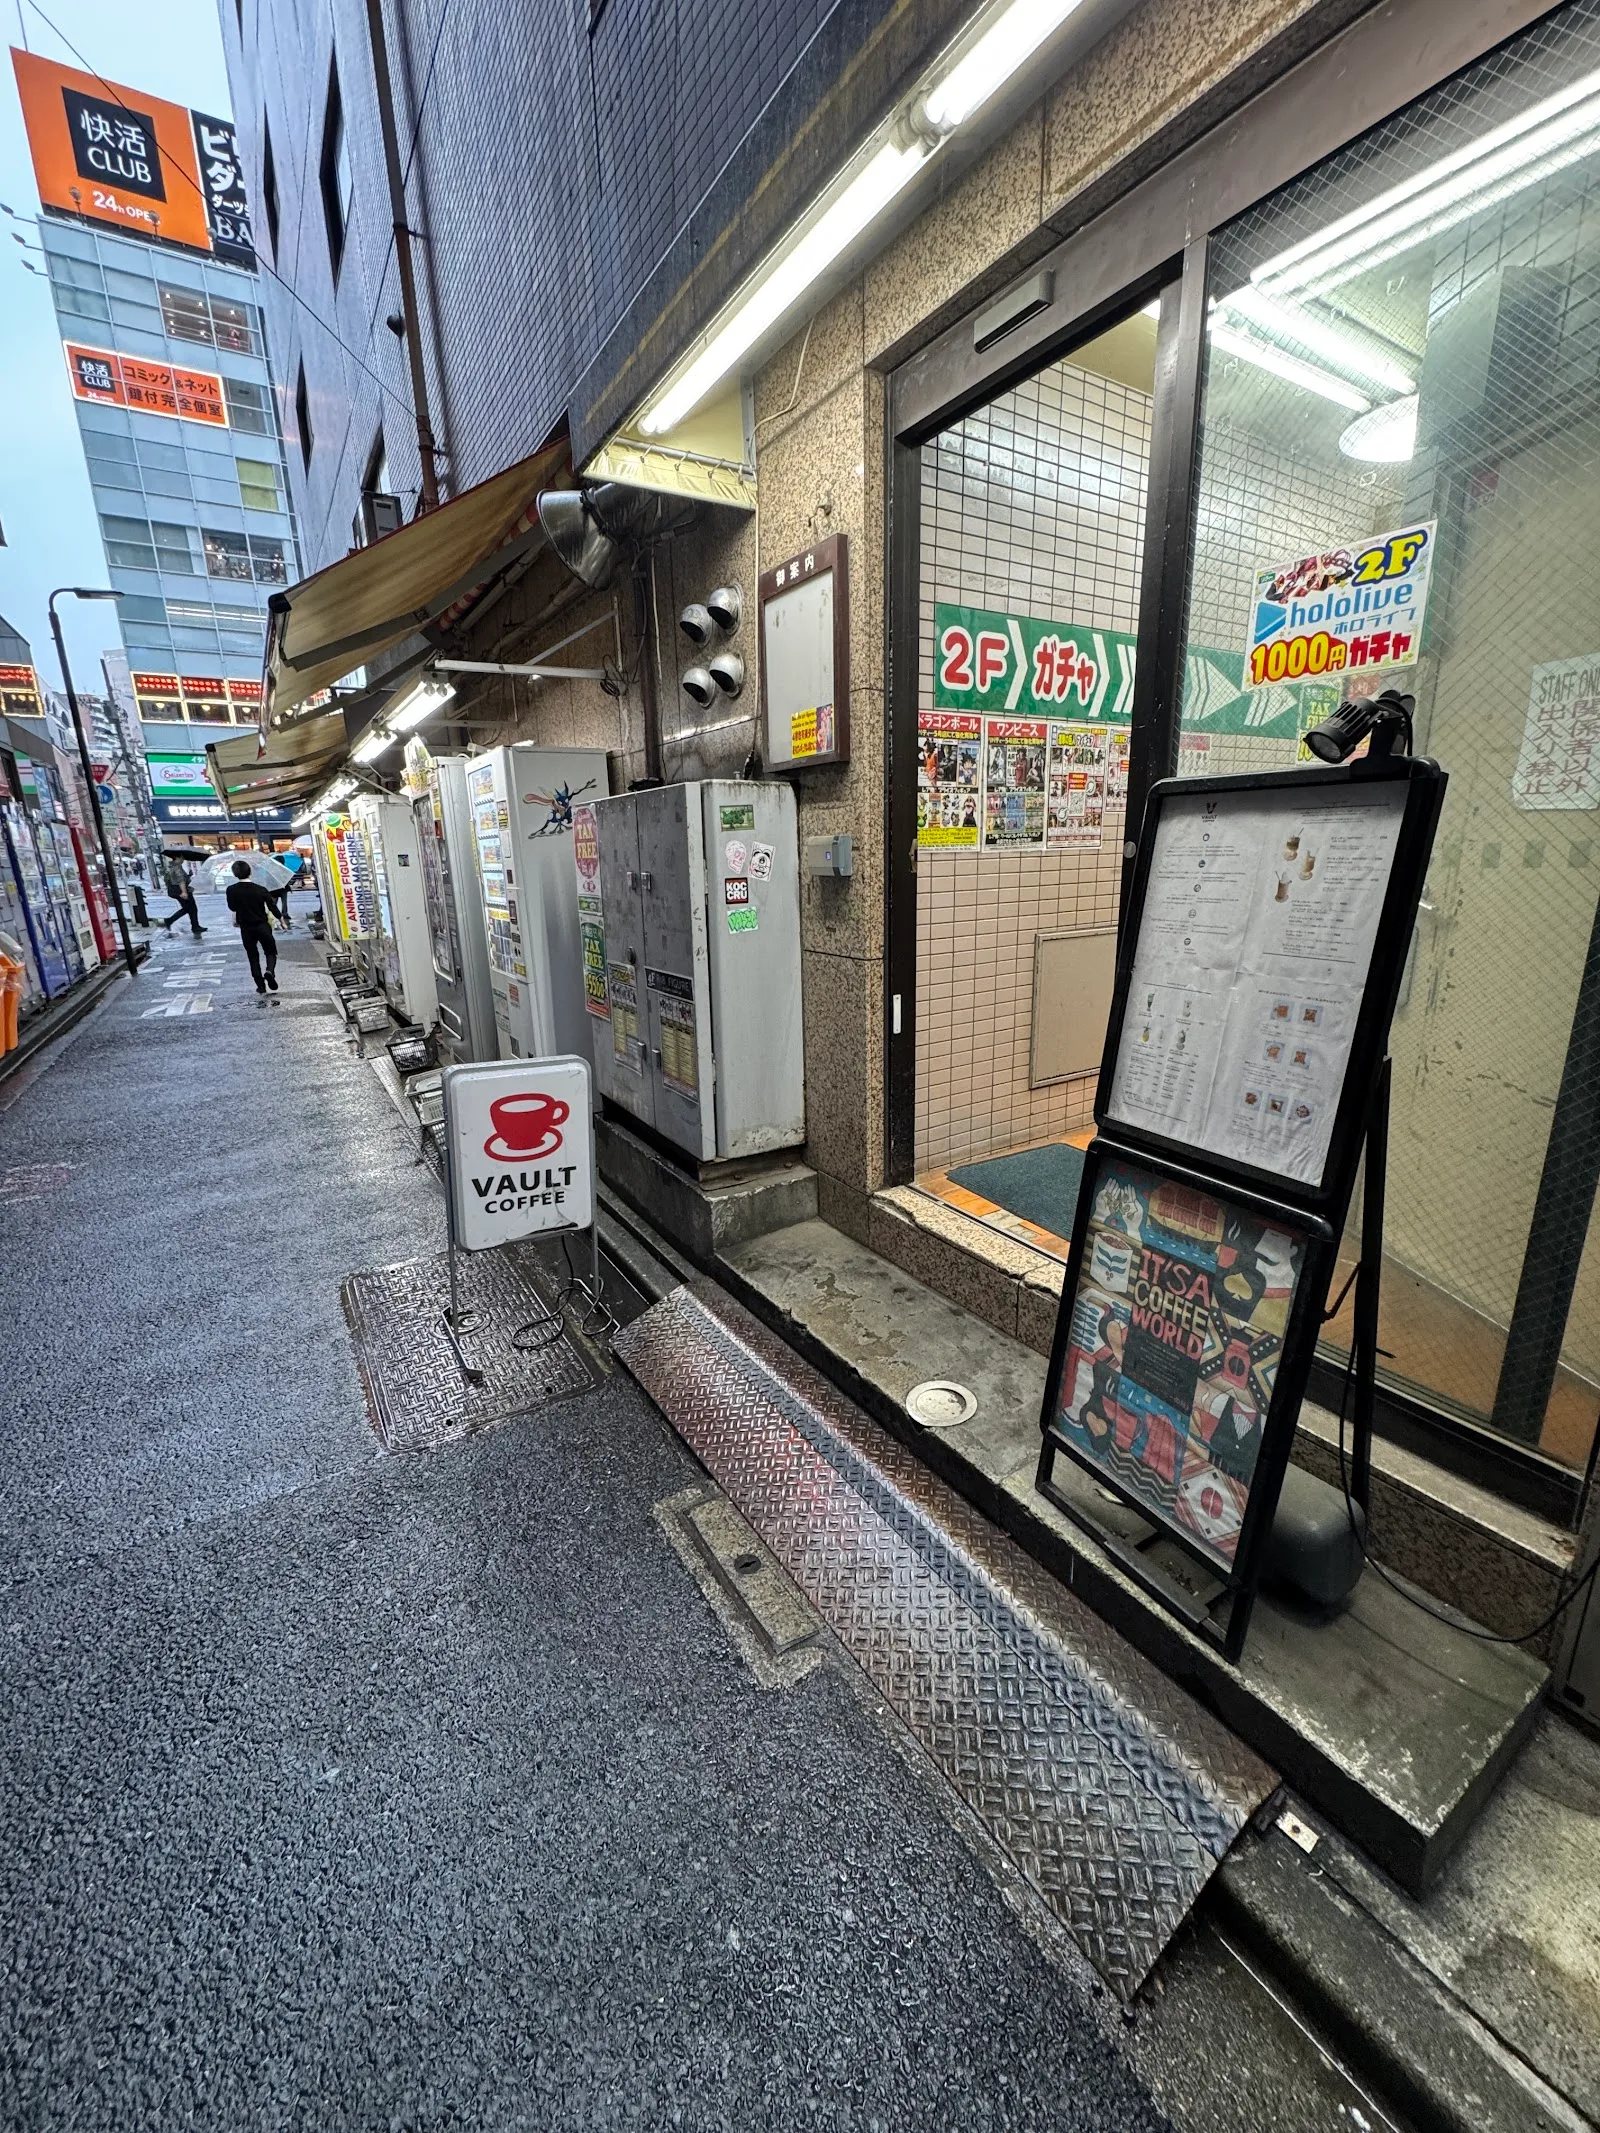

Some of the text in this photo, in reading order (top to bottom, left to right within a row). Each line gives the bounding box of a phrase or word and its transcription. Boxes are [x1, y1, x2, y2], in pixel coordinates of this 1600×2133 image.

[81, 108, 147, 157] 快活
[87, 147, 151, 184] CLUB
[92, 190, 161, 225] 24h OPE
[81, 360, 109, 377] 快活
[84, 374, 111, 389] CLUB
[127, 386, 222, 417] 鍵付完全個室
[775, 553, 815, 587] 御案内
[1353, 530, 1426, 586] 2F
[1290, 583, 1413, 629] hololive
[943, 629, 1095, 702] 2F ガチャ
[1539, 669, 1577, 705] STAFF
[1310, 700, 1331, 716] TAX
[996, 722, 1039, 737] ワンピース
[1520, 704, 1567, 795] 出入り禁止
[577, 823, 594, 840] TAX
[576, 842, 598, 859] FREE
[345, 831, 369, 933] VENDING MACHINE
[726, 881, 747, 891] KOC
[726, 890, 748, 900] CRU
[343, 887, 358, 922] ANIME
[584, 937, 601, 954] TAX
[584, 950, 604, 970] FREE
[471, 1166, 577, 1198] VAULT
[484, 1191, 565, 1214] COFFEE
[1138, 1248, 1211, 1308] IT'S A
[1134, 1279, 1210, 1340] COFFEE
[1131, 1302, 1203, 1361] WORLD
